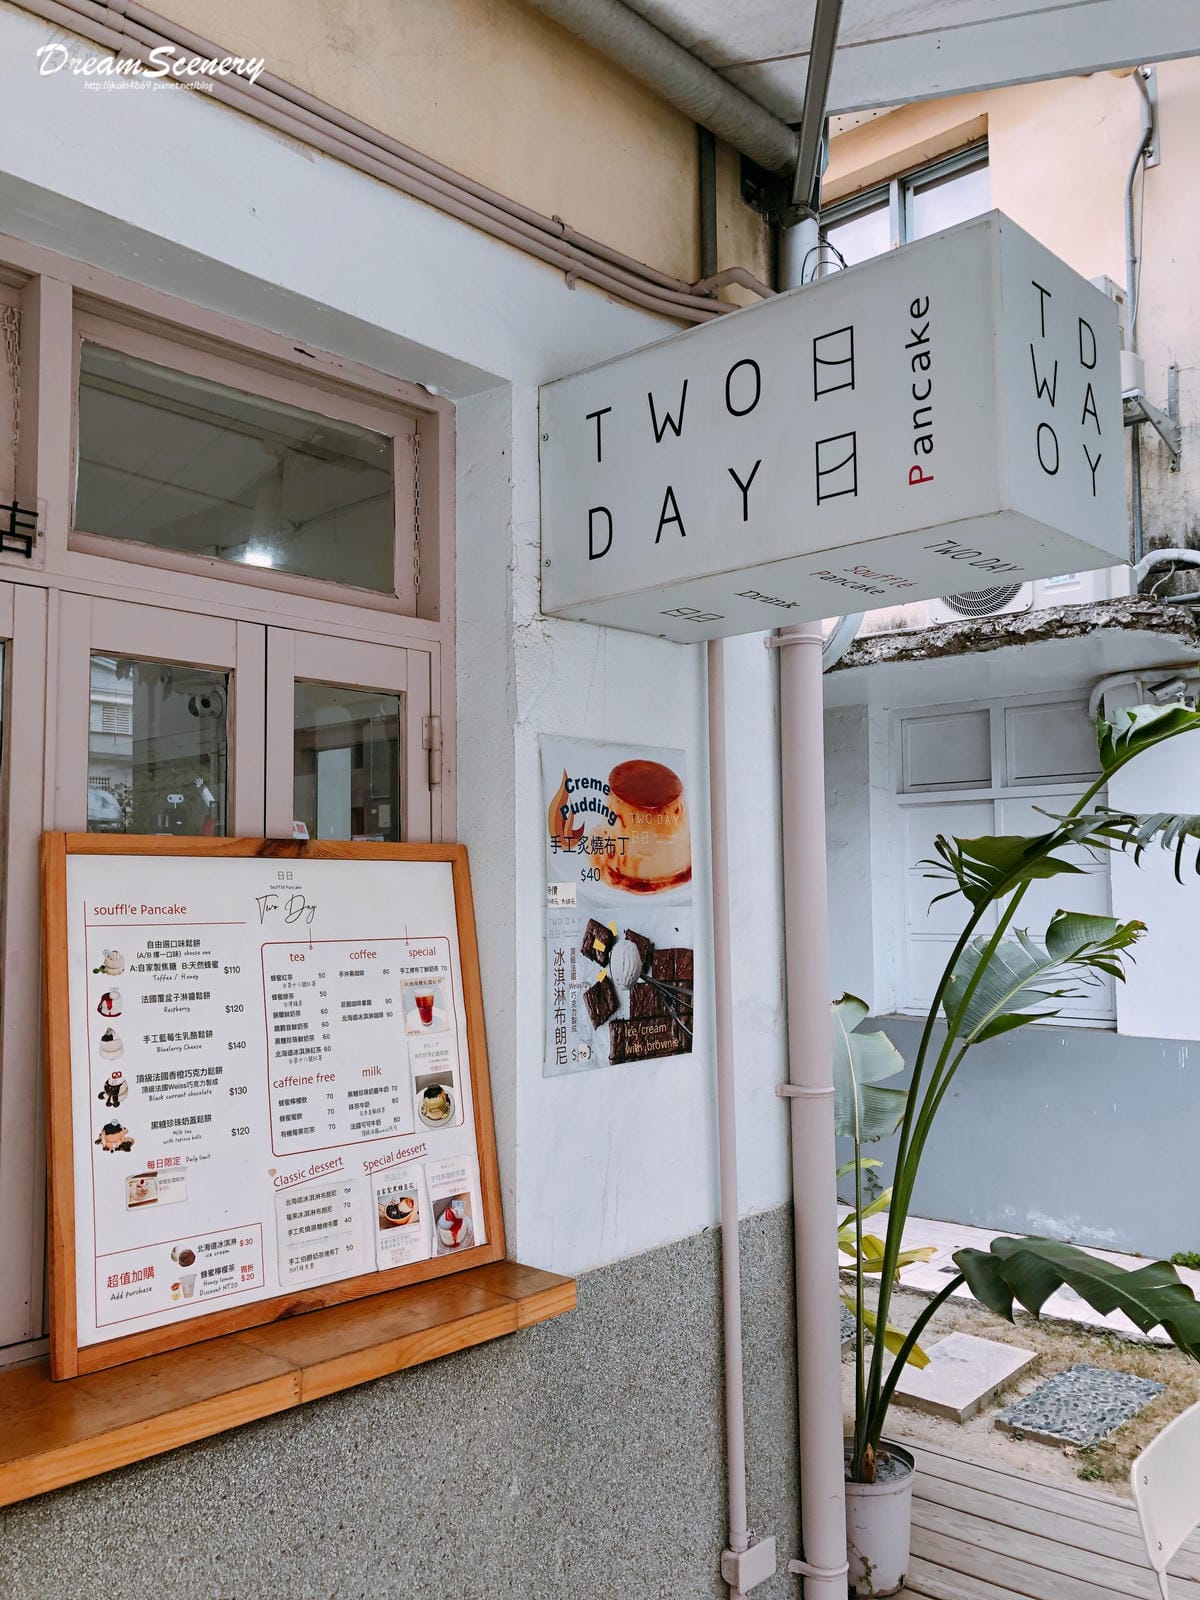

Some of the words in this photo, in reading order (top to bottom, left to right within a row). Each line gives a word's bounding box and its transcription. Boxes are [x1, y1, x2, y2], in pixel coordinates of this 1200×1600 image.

[1030, 280, 1061, 476] TWO
[904, 296, 935, 486] Pancake
[586, 358, 761, 463] TWO
[1078, 316, 1103, 498] DAY
[588, 459, 762, 561] DAY
[922, 539, 983, 561] TWO
[968, 557, 1025, 575] DAY
[809, 570, 885, 596] Pancake
[735, 590, 801, 611] Drink
[564, 777, 611, 796] Creme
[629, 812, 653, 825] TWO
[657, 814, 680, 825] DAY
[550, 835, 630, 856] 手工炙燒布丁
[580, 867, 601, 882] $40
[141, 903, 187, 915] Pancake
[256, 894, 279, 924] Two
[285, 894, 318, 924] Day
[290, 953, 305, 962] tea
[349, 950, 377, 960] coffee
[408, 947, 436, 958] special
[224, 966, 241, 975] $110
[225, 1004, 244, 1014] $120
[553, 947, 568, 1066] 冰淇淋布朗尼
[624, 1025, 638, 1037] Ice
[641, 1023, 667, 1035] cream
[227, 1041, 247, 1051] $140
[625, 1041, 643, 1054] with
[646, 1038, 680, 1051] brownie
[361, 1066, 382, 1077] milk
[273, 1075, 313, 1088] caffeine
[316, 1072, 336, 1083] free
[229, 1086, 248, 1096] $130
[231, 1127, 250, 1137] $120
[147, 1156, 181, 1169] 每日限定
[362, 1154, 394, 1172] Special
[396, 1142, 427, 1160] dessert
[273, 1170, 307, 1187] Classic
[308, 1156, 343, 1176] dessert
[345, 1244, 354, 1252] 50
[107, 1266, 155, 1288] 超值加購
[110, 1291, 124, 1301] Add
